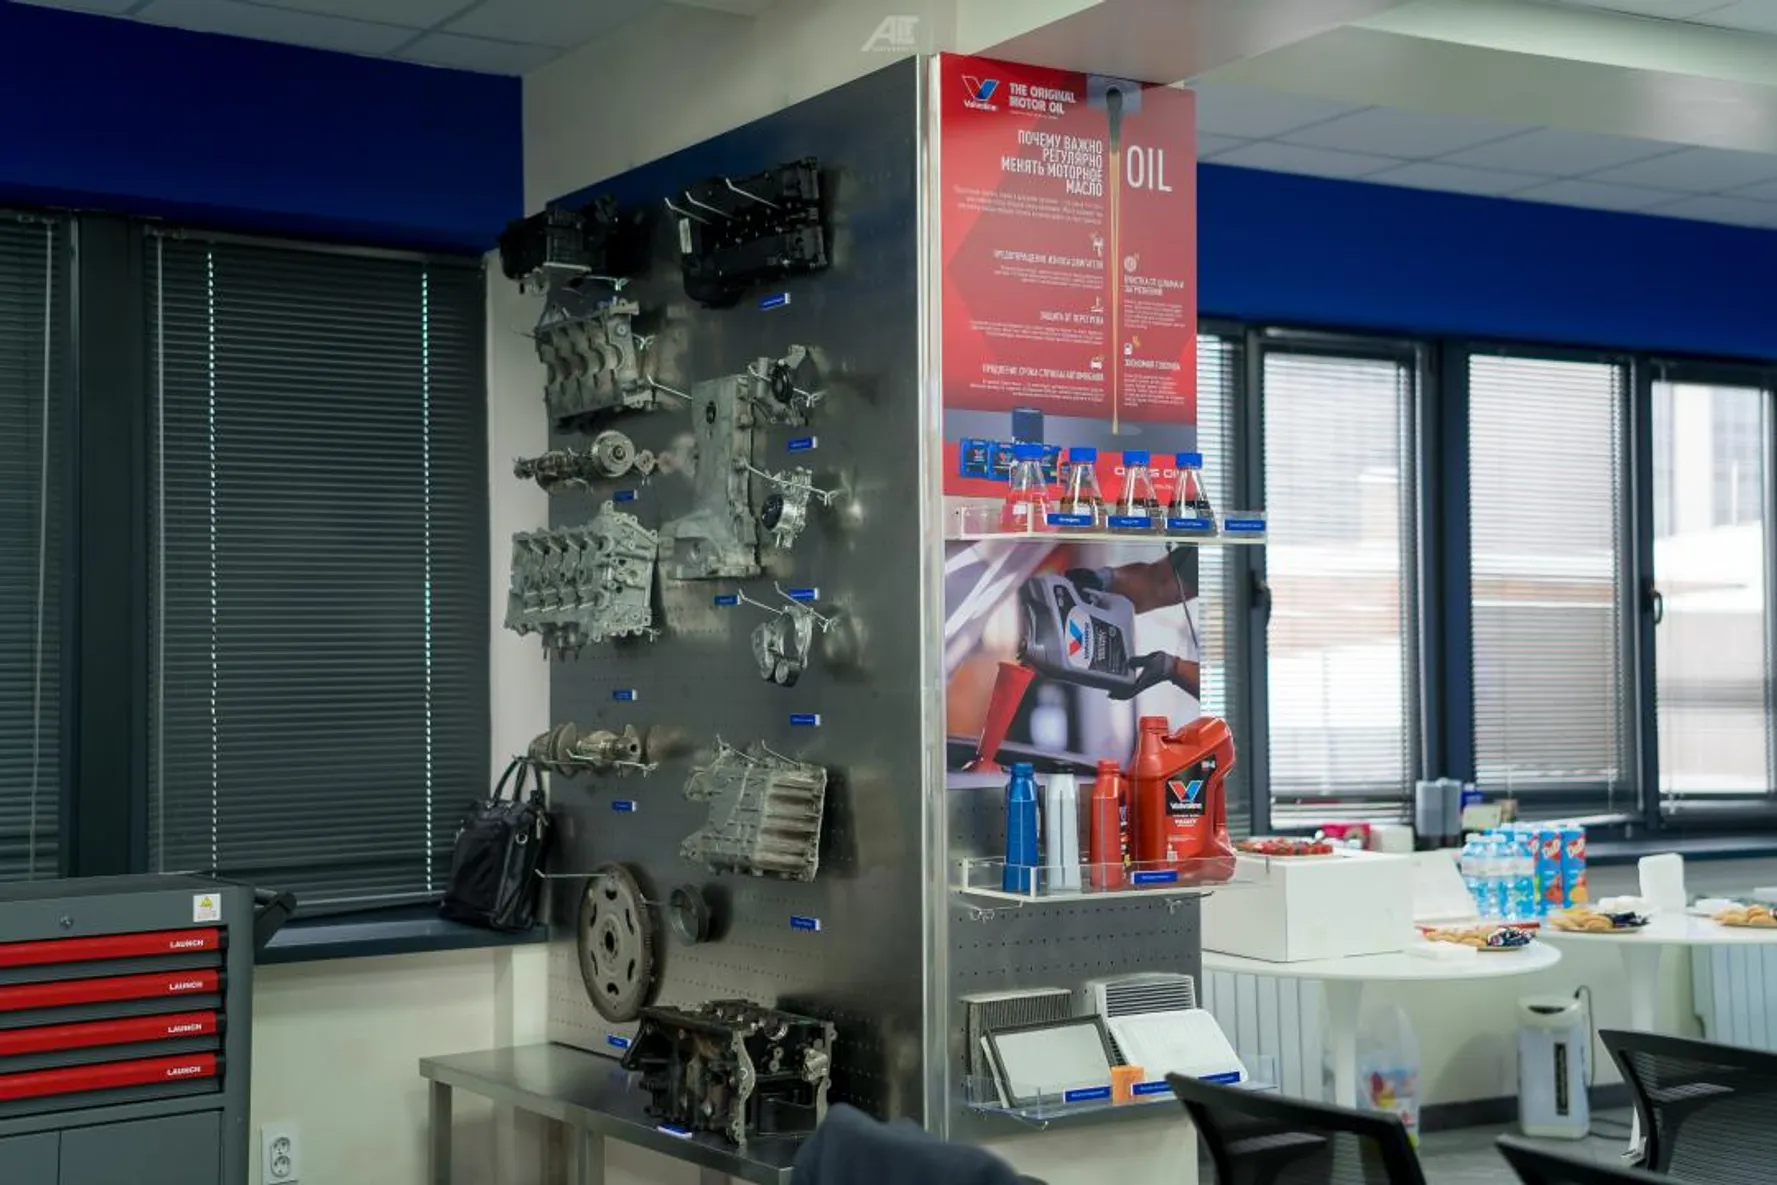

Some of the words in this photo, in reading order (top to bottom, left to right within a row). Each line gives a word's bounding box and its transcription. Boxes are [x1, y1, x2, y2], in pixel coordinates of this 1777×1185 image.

[1009, 82, 1028, 96] THE
[1030, 86, 1076, 104] ORIGINAL
[1008, 95, 1046, 112] MOTOR
[1049, 101, 1065, 115] OIL
[1017, 129, 1062, 149] ПОЧЕМУ
[1063, 134, 1103, 154] ВАЖНО
[1042, 148, 1103, 169] РЕГУЛЯРНО
[1126, 144, 1173, 193] OIL
[1001, 156, 1045, 175] МЕНЯТЬ
[1047, 163, 1103, 183] МОТОРНОЕ
[1066, 180, 1103, 197] МАСЛО
[169, 939, 204, 949] LAUNCH
[169, 981, 203, 990] LAUNCH
[167, 1023, 202, 1033] LAUNCH
[167, 1066, 201, 1076] LAUNCH
